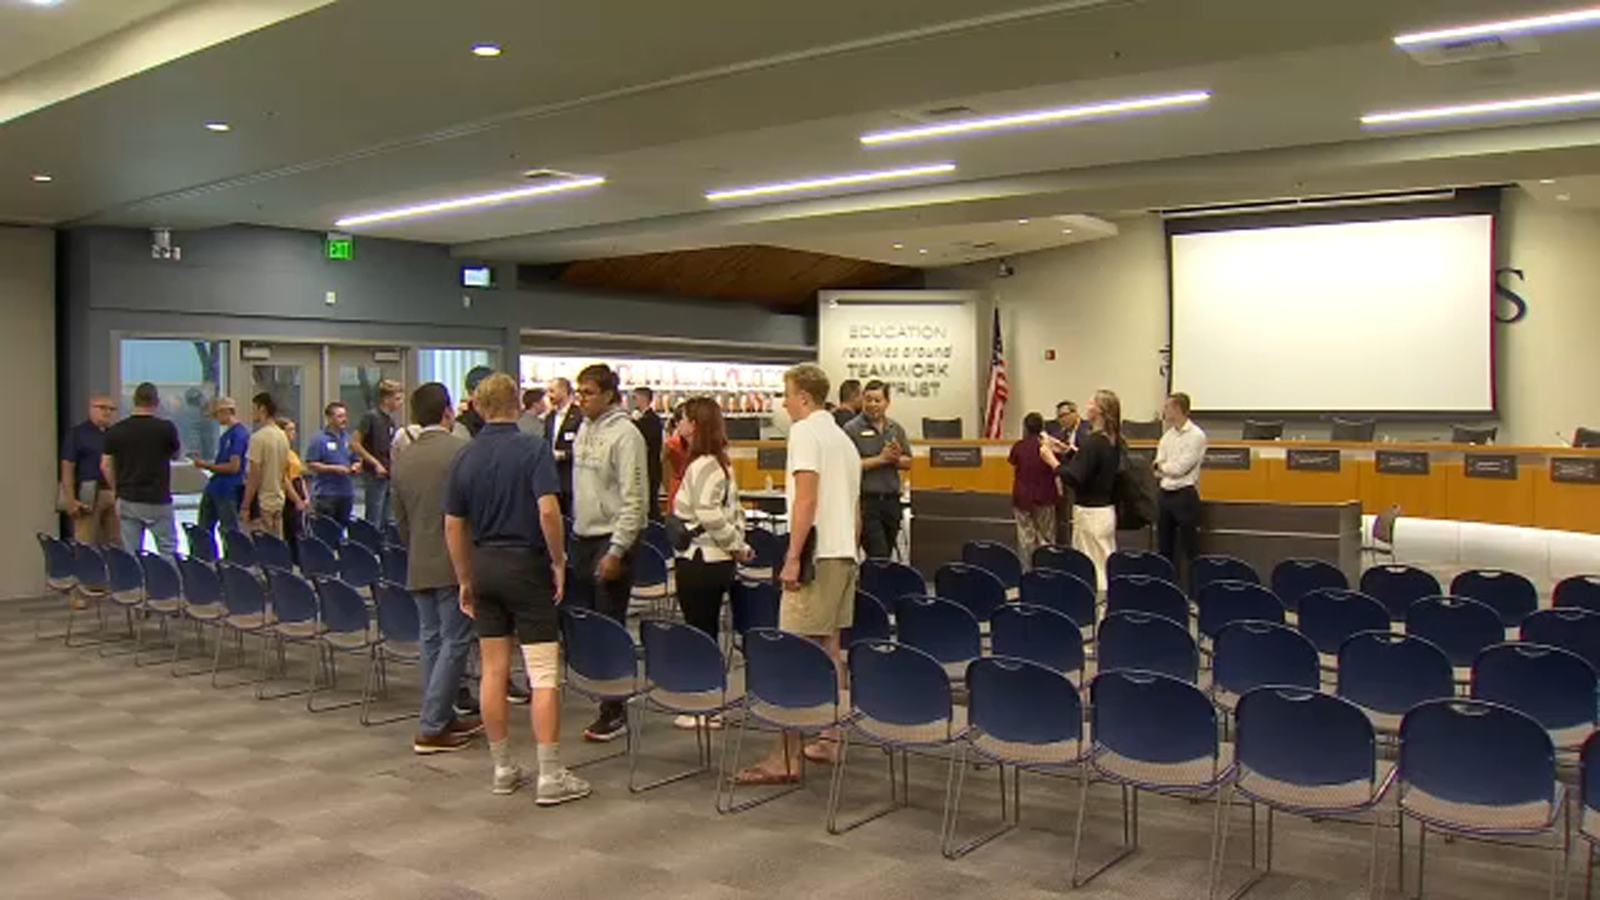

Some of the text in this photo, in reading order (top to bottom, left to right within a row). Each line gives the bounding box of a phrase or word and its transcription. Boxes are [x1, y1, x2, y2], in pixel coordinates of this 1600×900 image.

[848, 324, 947, 340] EDUCATION
[841, 344, 953, 359] revolves around
[846, 362, 950, 378] TEAMWORK
